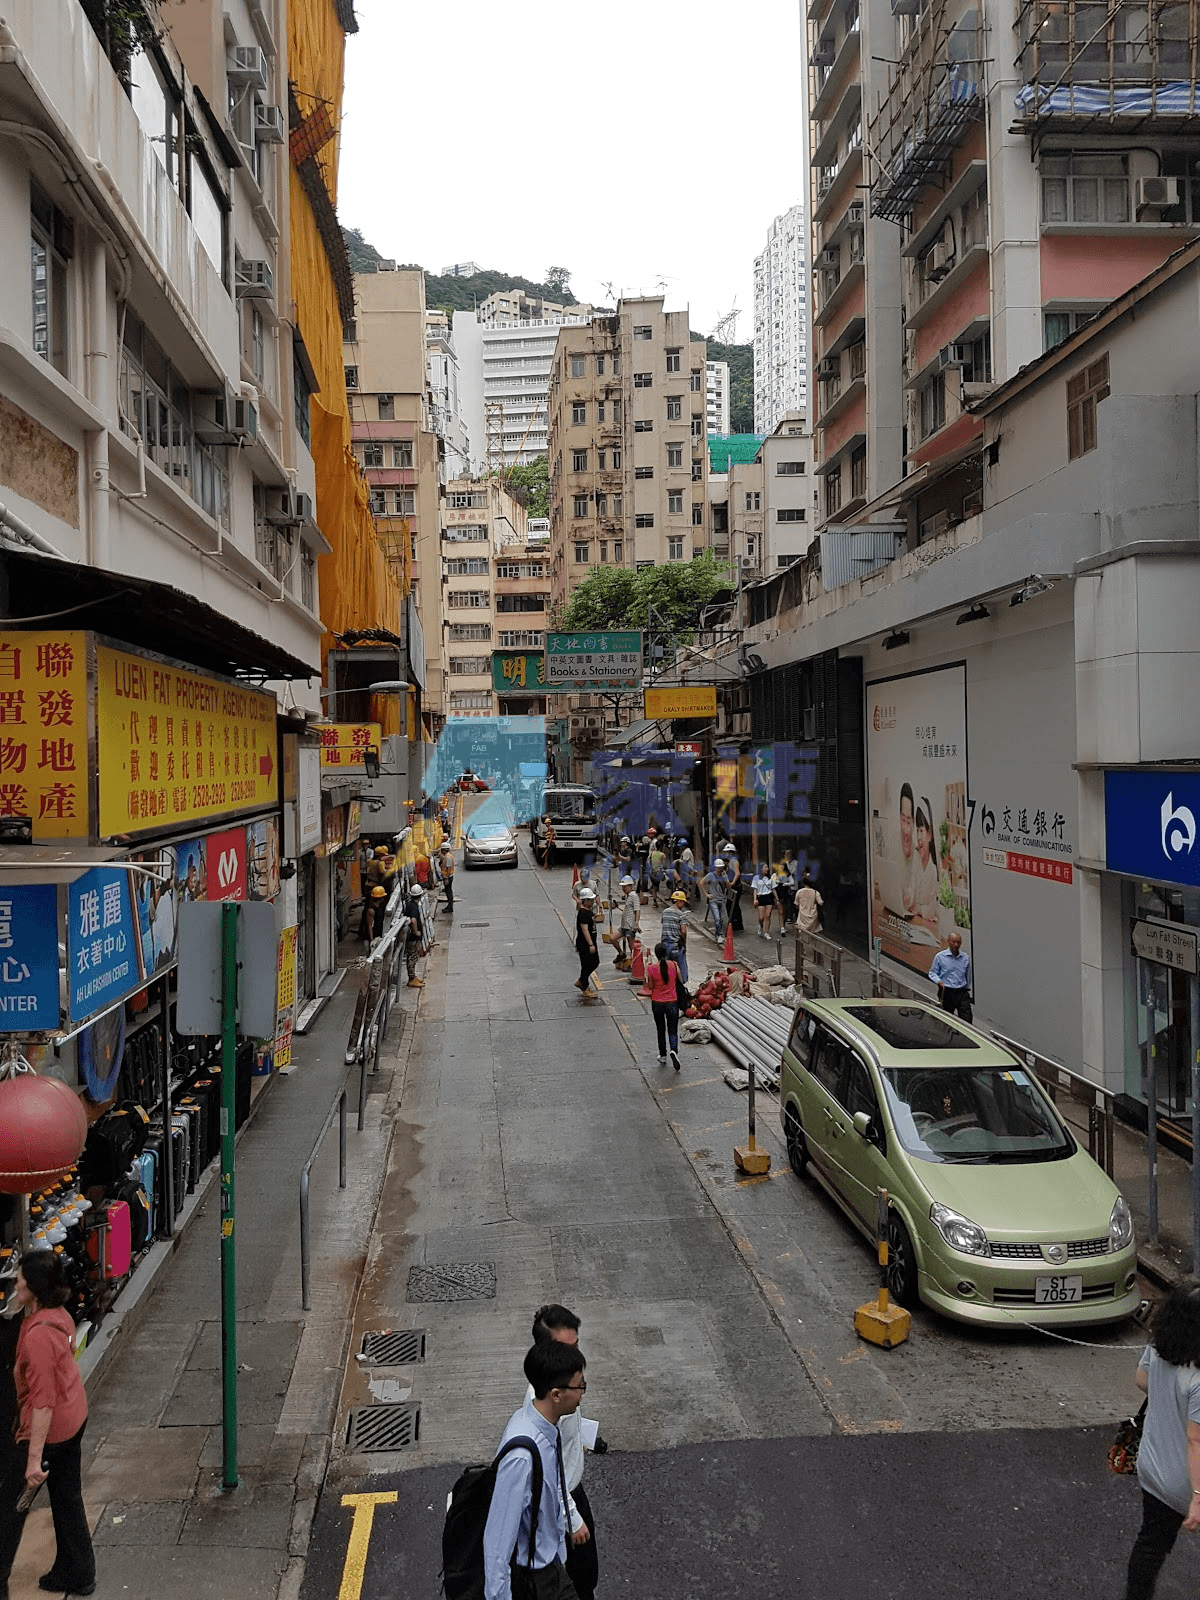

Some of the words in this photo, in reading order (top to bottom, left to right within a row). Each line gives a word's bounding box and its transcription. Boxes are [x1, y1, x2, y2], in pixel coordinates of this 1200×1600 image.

[550, 665, 579, 676] Books
[581, 668, 587, 676] &
[589, 665, 638, 677] Stationery
[115, 659, 147, 701] LUEN
[153, 670, 171, 705] FAT
[176, 676, 219, 713] PROPERTY
[222, 688, 248, 719] AGENCY
[35, 642, 77, 820] 聯發地產
[320, 728, 371, 746] 聯發
[471, 744, 487, 752] FAB
[1003, 805, 1066, 840] 交通銀行
[997, 833, 1011, 844] BANK
[1013, 835, 1021, 844] OF
[1022, 837, 1073, 854] COMMUNICATIONS
[79, 880, 122, 938] 雅麗
[1146, 927, 1158, 938] Lun
[1159, 930, 1171, 942] Fat
[1172, 934, 1194, 949] Street
[1155, 945, 1184, 966] 聯發街
[76, 986, 84, 1005] AH
[93, 969, 112, 994] FASHION
[112, 960, 129, 984] CENTER
[1050, 1276, 1068, 1289] ST
[1041, 1288, 1077, 1301] 7057
